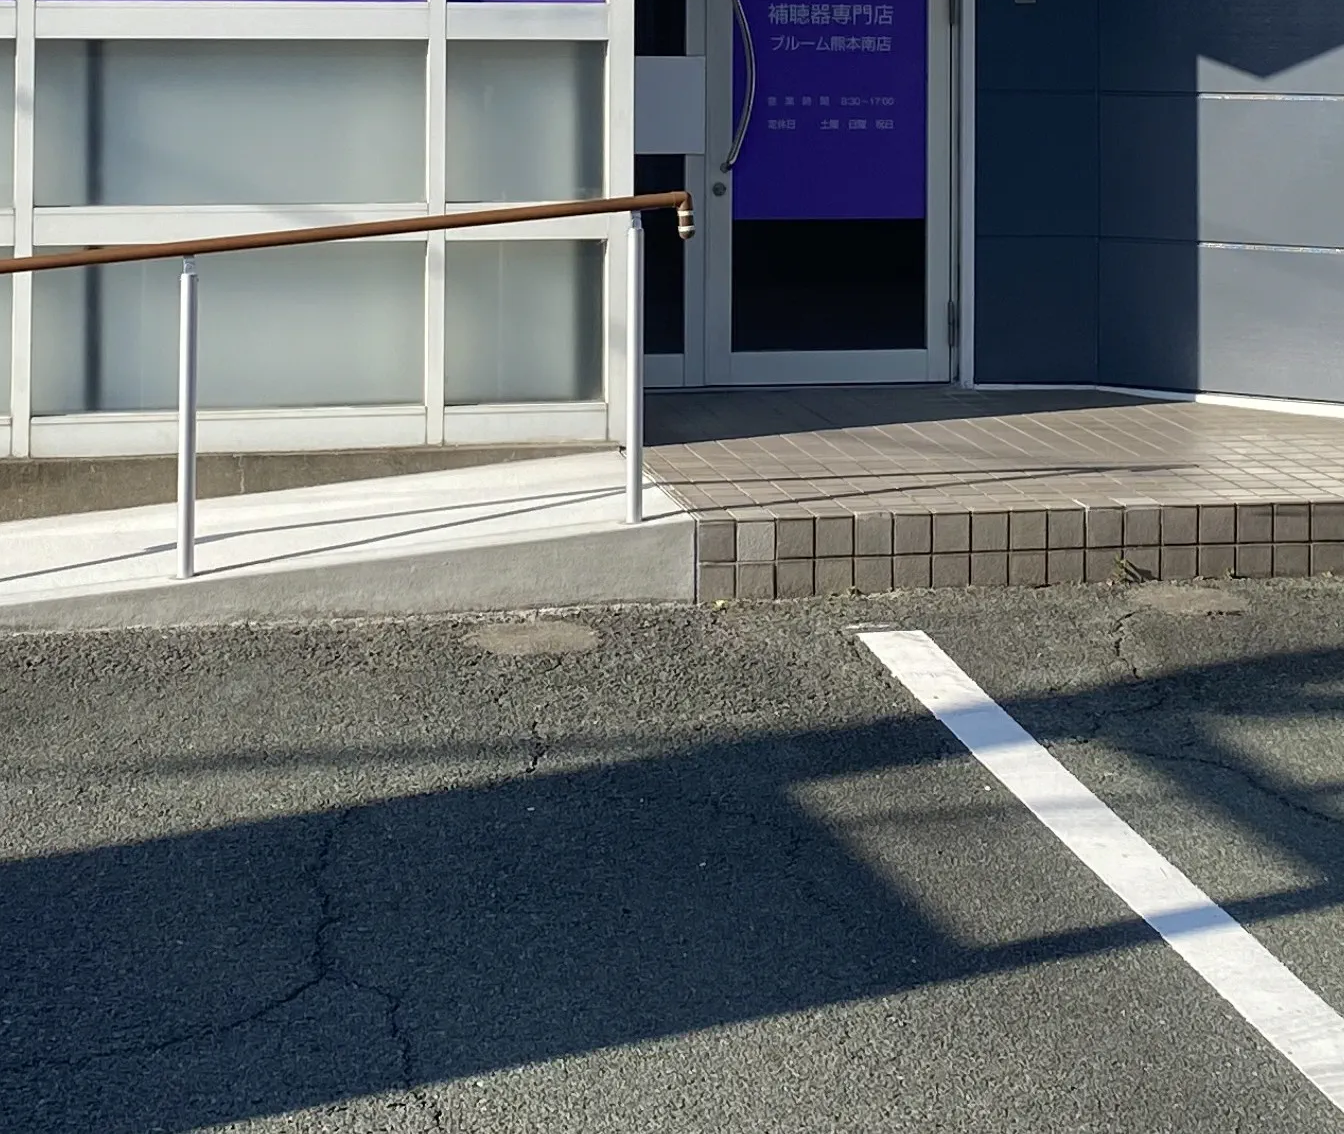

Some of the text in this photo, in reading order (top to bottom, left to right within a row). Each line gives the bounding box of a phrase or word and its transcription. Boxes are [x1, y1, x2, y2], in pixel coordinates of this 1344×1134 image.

[767, 3, 894, 26] 補聴器専門店
[770, 35, 892, 52] ブルーム熊本南店
